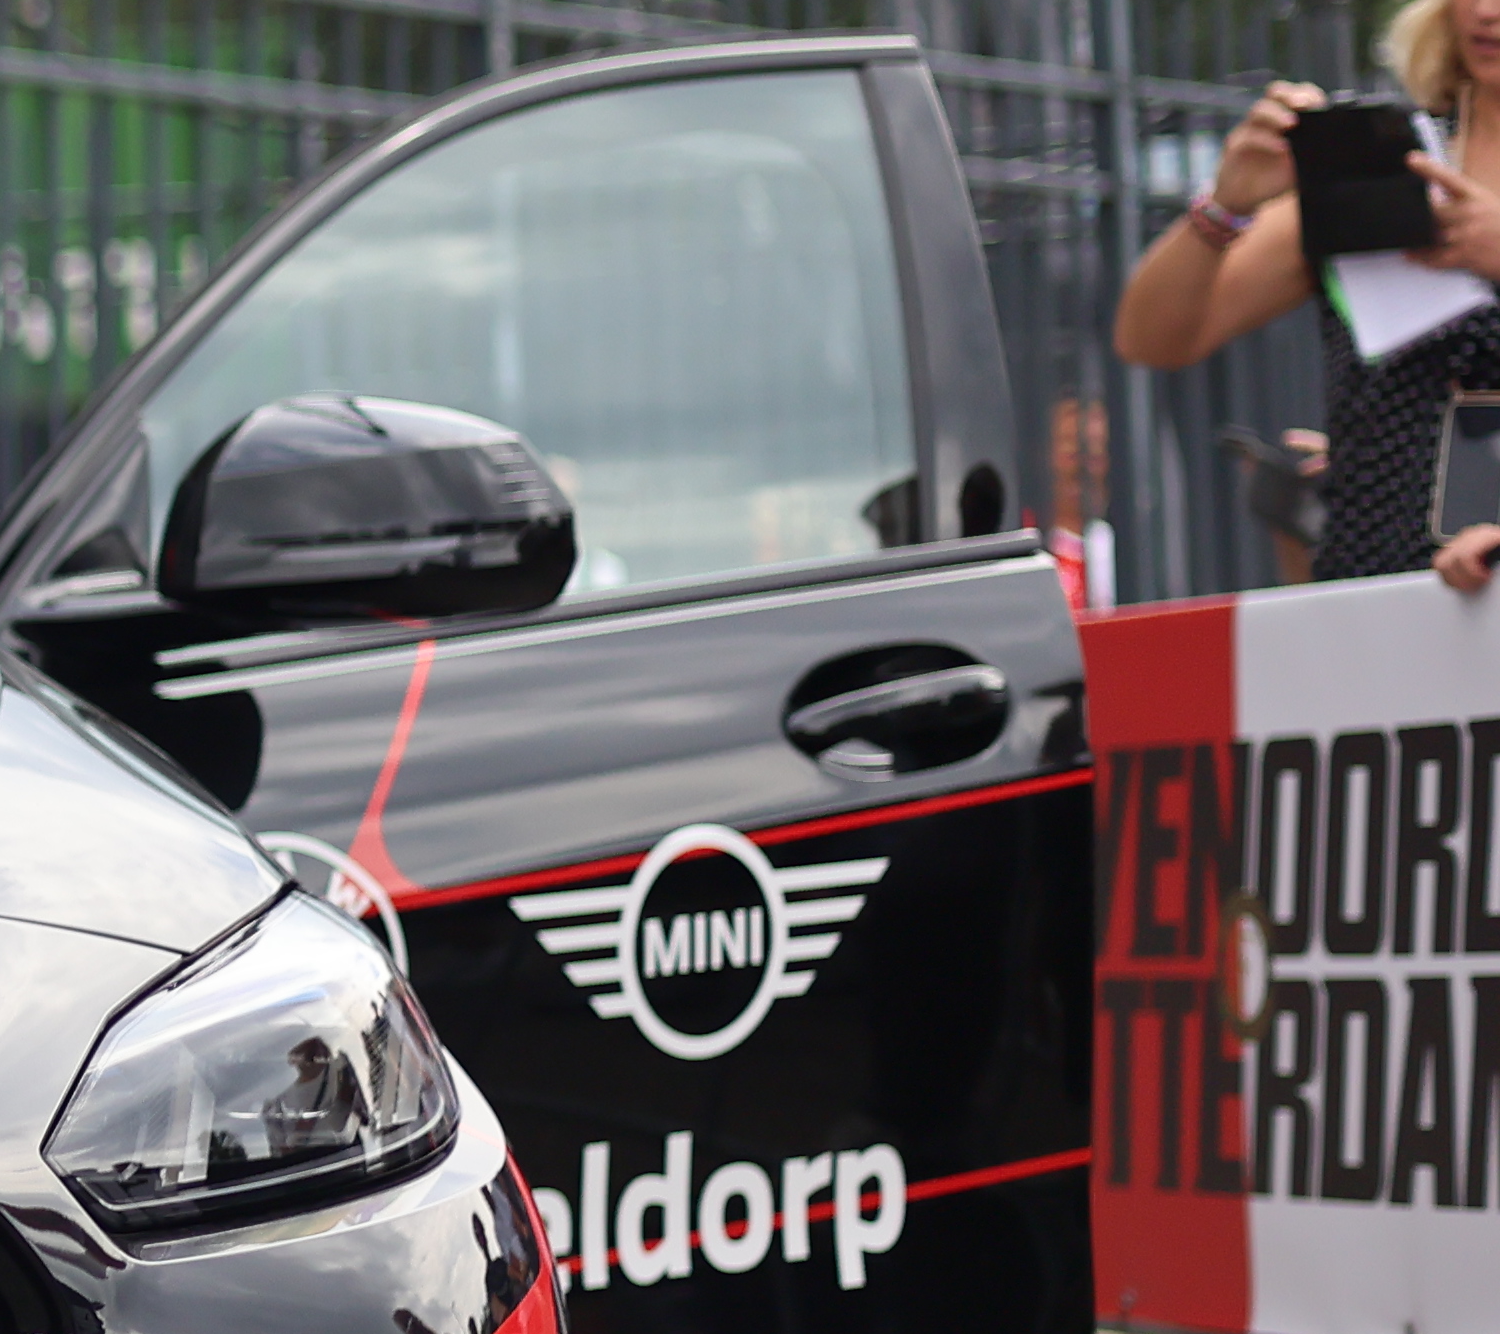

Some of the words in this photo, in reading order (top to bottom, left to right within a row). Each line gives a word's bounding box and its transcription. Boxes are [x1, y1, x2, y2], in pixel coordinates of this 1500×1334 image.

[643, 905, 764, 979] MINI
[1102, 977, 1500, 1209] TTERDA
[532, 1130, 906, 1291] eldorp
